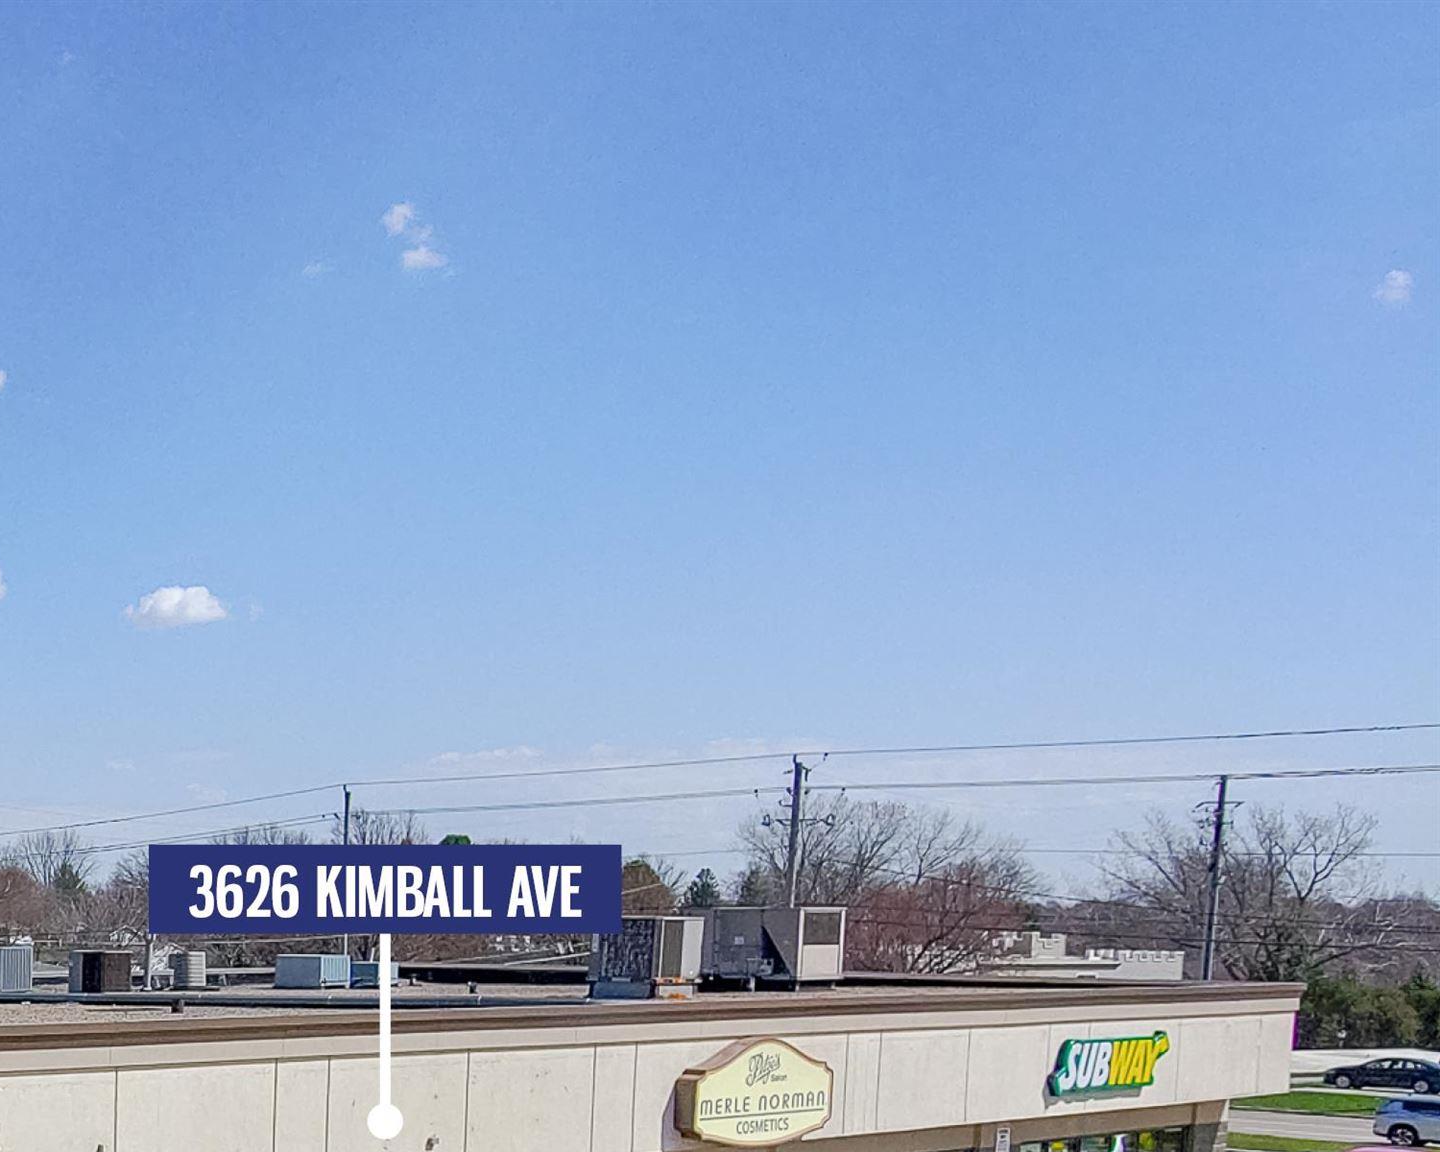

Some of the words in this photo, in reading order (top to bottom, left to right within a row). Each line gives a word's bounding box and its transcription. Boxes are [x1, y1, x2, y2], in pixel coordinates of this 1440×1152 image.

[1056, 1034, 1168, 1091] SUBWAY
[700, 1096, 751, 1117] MERLE
[758, 1090, 825, 1112] NORMAN
[736, 1117, 790, 1135] COSMETICS
